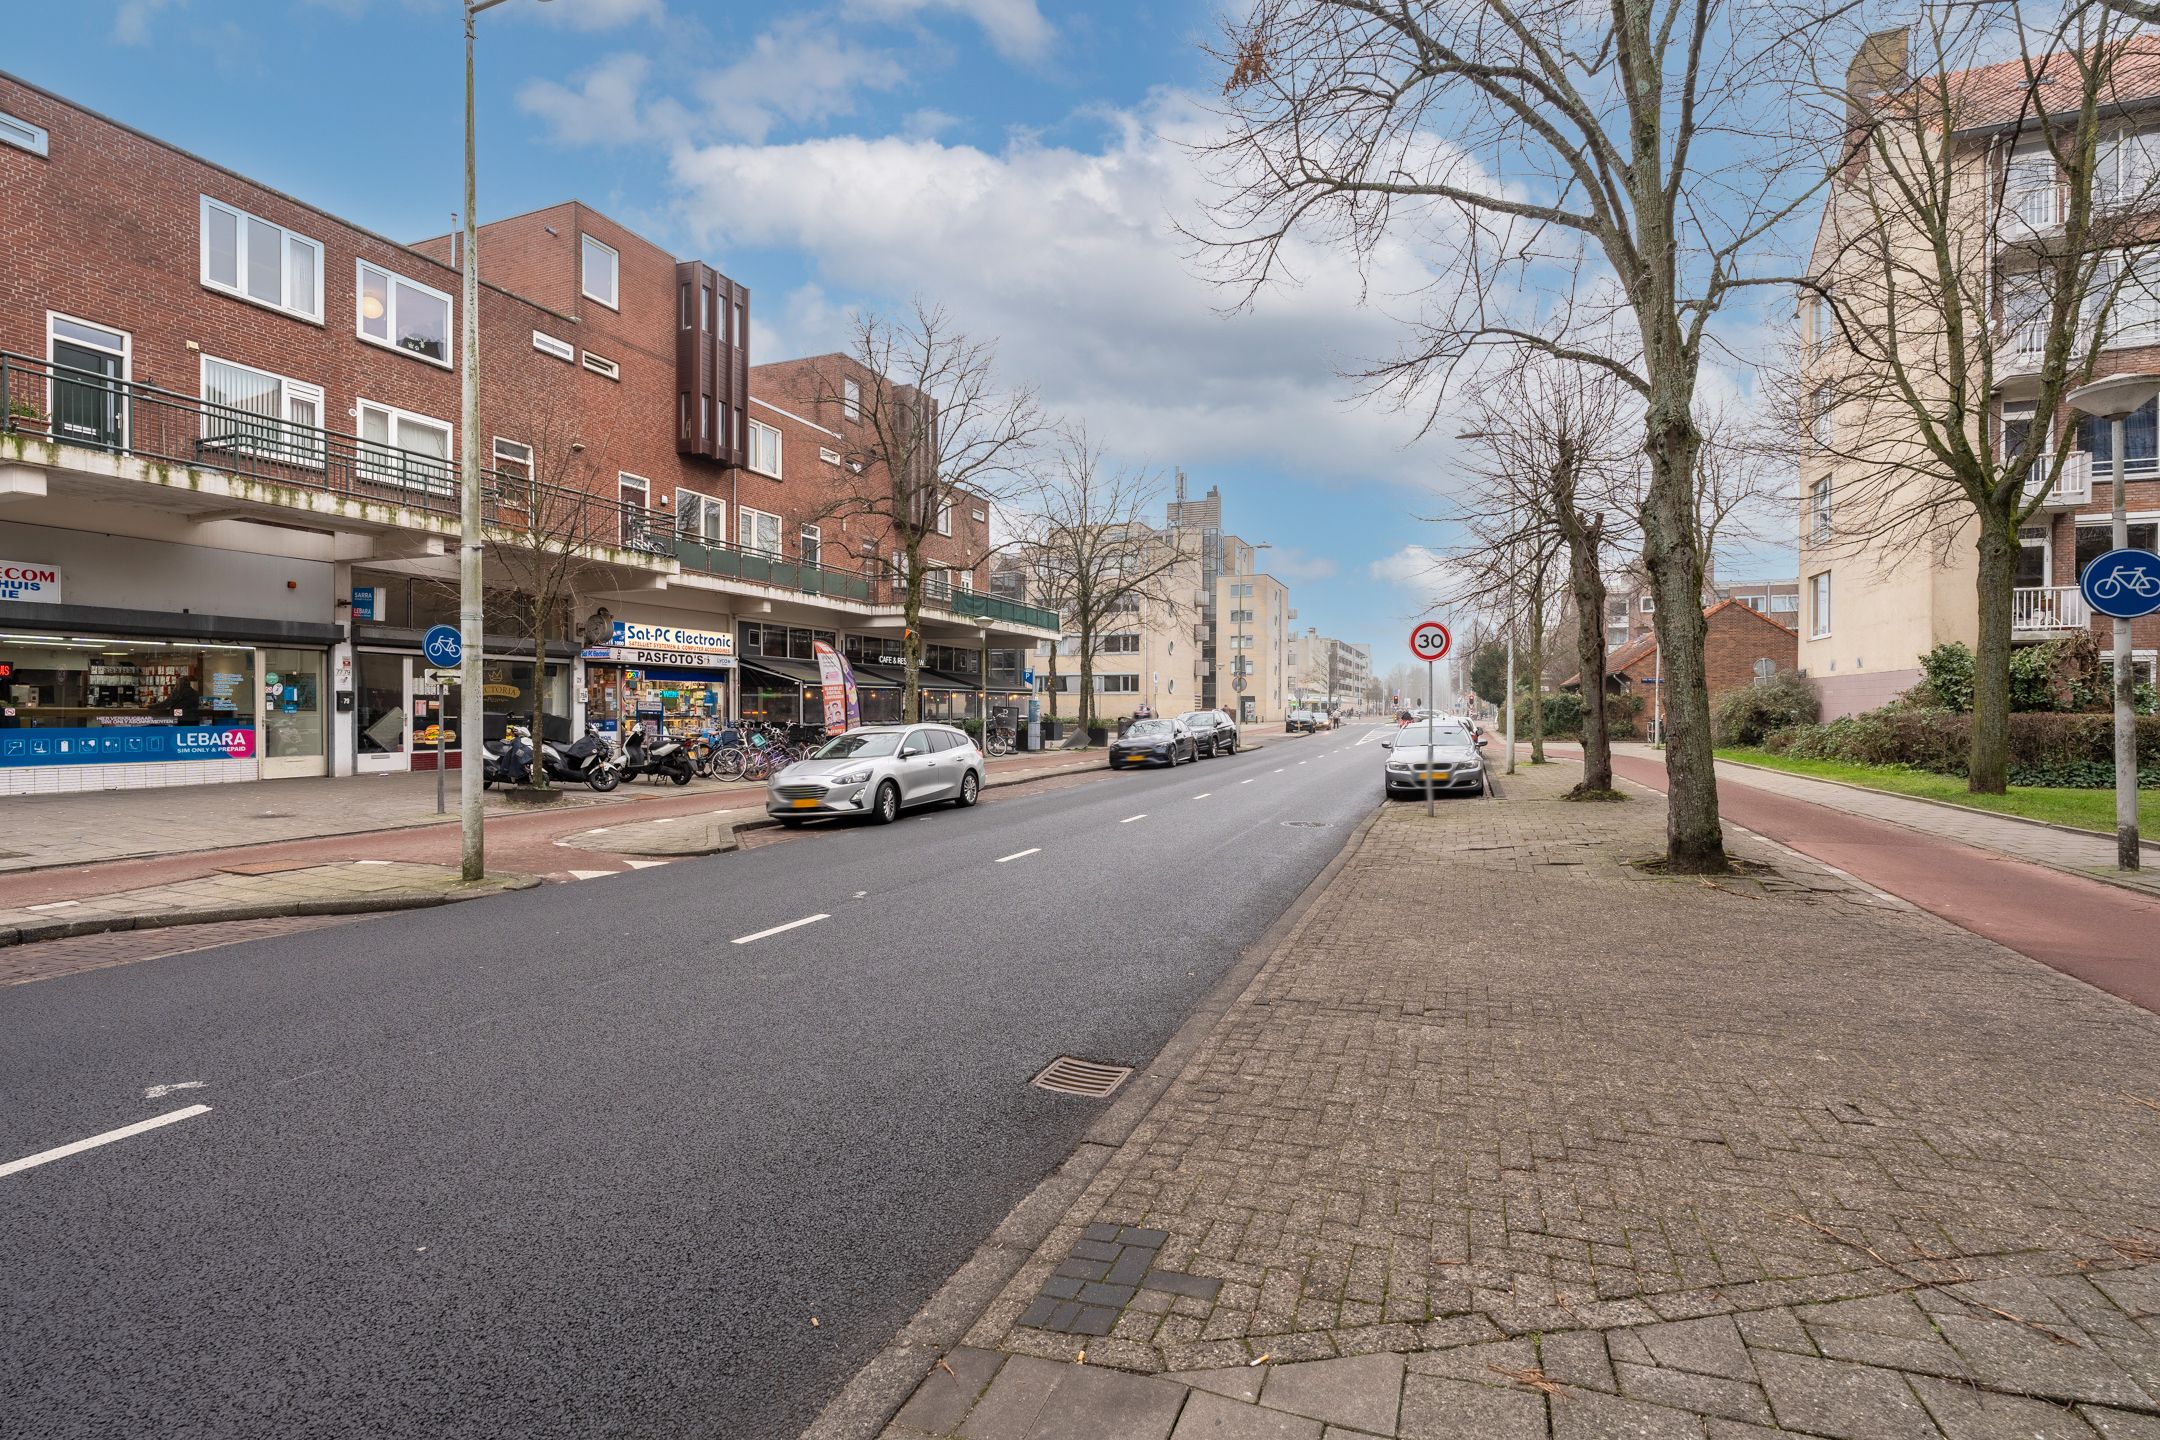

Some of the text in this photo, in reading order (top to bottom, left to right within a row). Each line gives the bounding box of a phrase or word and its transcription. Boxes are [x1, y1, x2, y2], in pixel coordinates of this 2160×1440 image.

[0, 566, 55, 583] COM
[0, 580, 41, 591] HUIS
[353, 607, 371, 615] LEBARA
[627, 625, 731, 648] Sat-PC Electronic
[1417, 633, 1444, 649] 30
[628, 640, 653, 648] SATELLIET
[653, 642, 676, 650] SYSTEMEN
[681, 644, 704, 652] COMPUTER
[637, 651, 704, 665] PASFOTO'S
[484, 685, 517, 696] CTORIA
[176, 732, 246, 746] LEBARA
